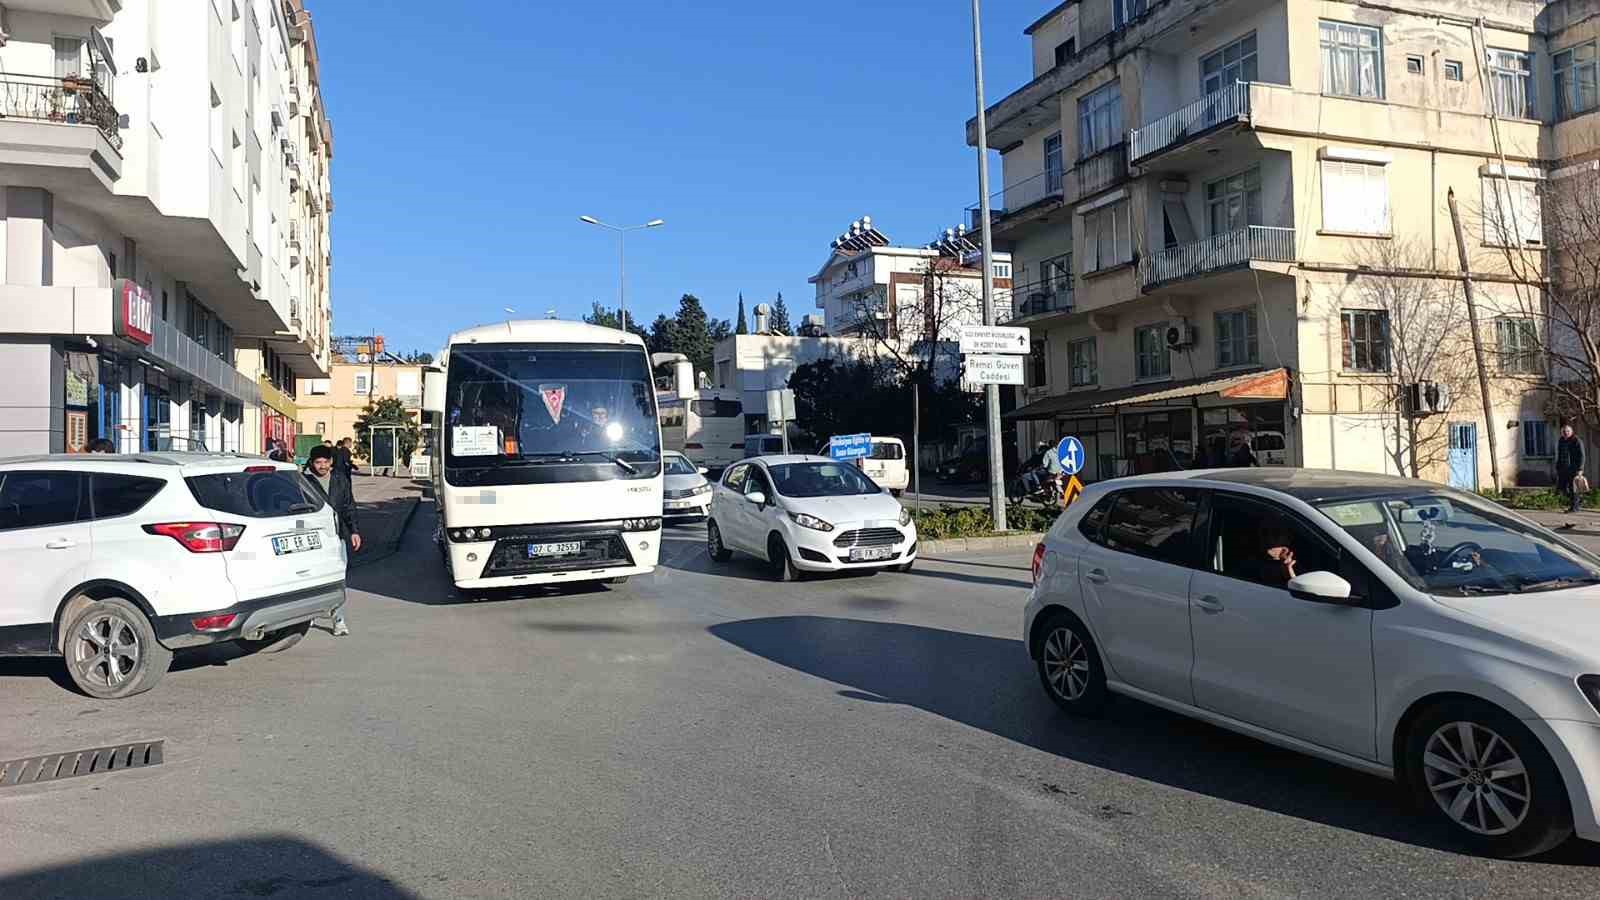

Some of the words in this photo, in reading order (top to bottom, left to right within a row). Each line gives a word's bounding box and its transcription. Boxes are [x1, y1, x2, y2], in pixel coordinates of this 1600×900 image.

[969, 359, 993, 370] Remzi
[980, 370, 1011, 382] Caddesi
[533, 544, 543, 553] 07
